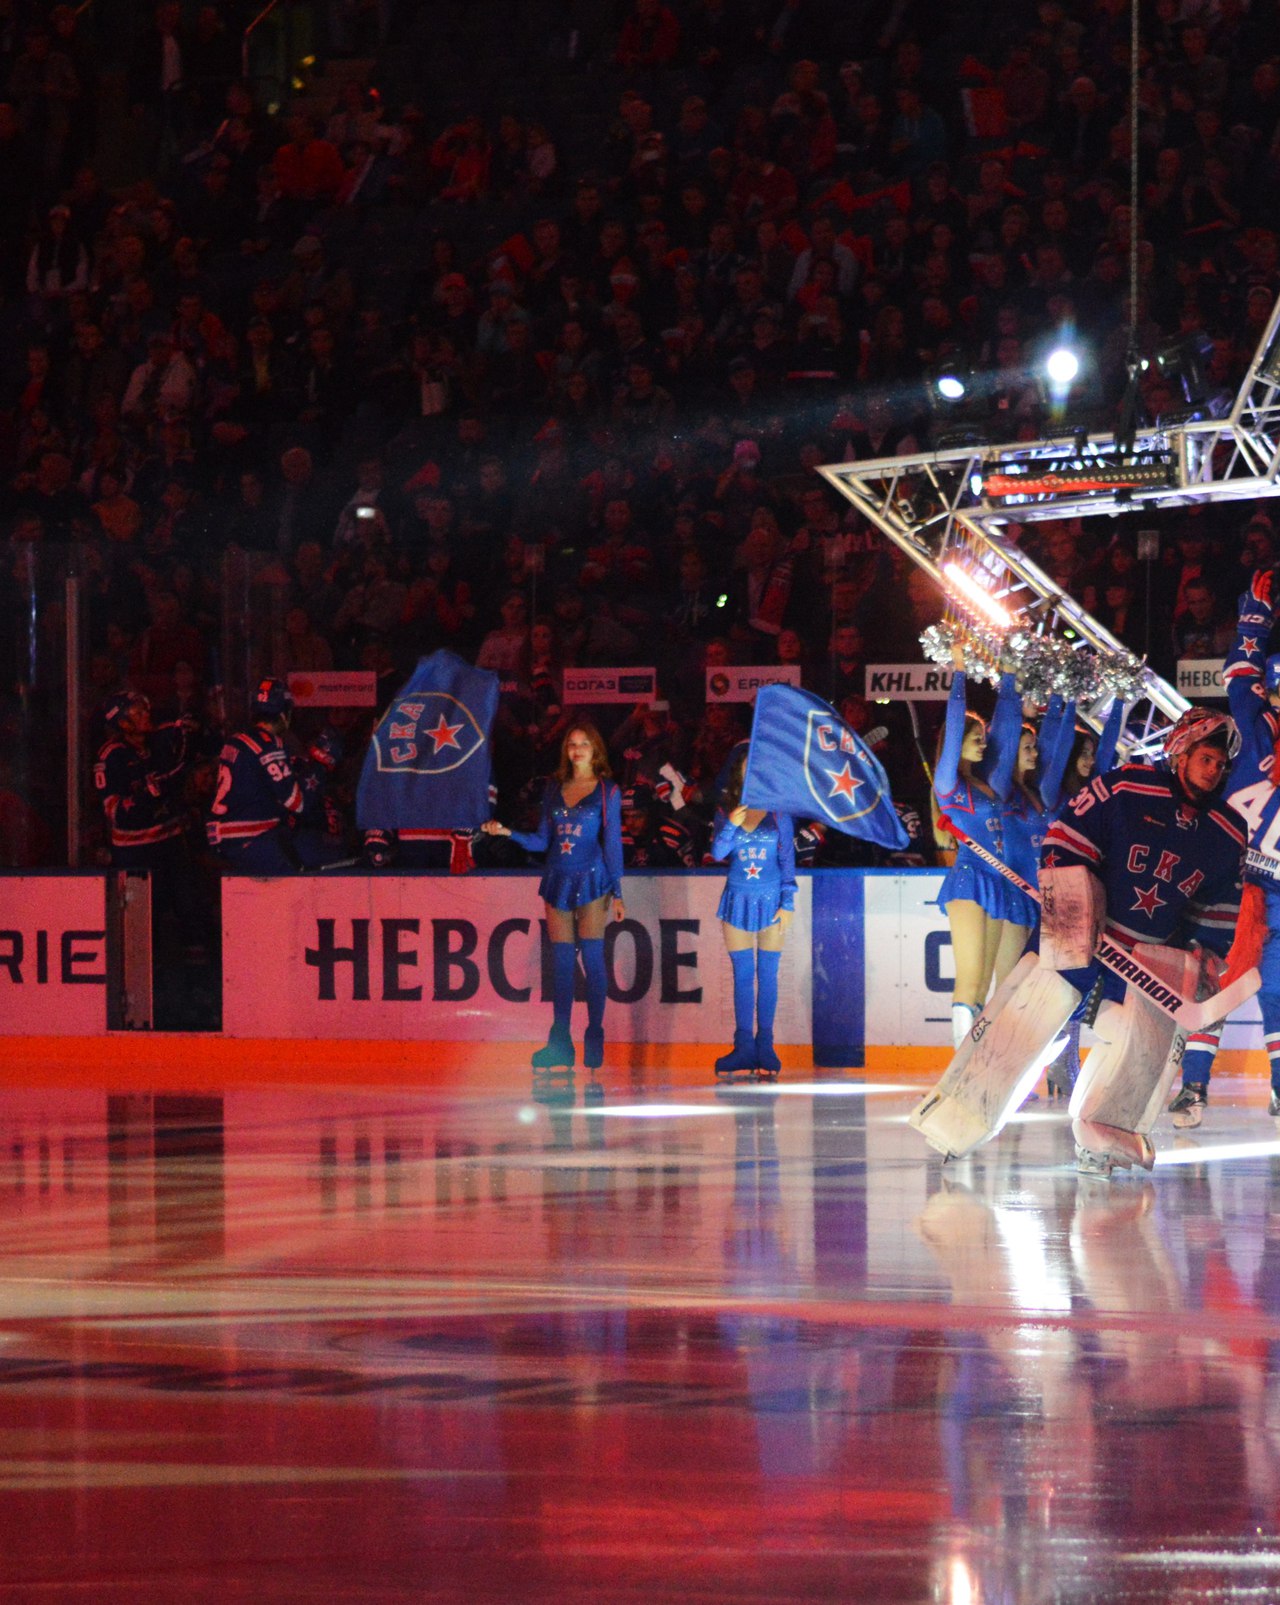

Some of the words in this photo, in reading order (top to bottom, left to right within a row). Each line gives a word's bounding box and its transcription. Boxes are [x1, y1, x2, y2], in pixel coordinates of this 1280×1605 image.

[389, 703, 426, 764] СКА
[1068, 775, 1110, 817] 30
[1127, 843, 1206, 898] СКА
